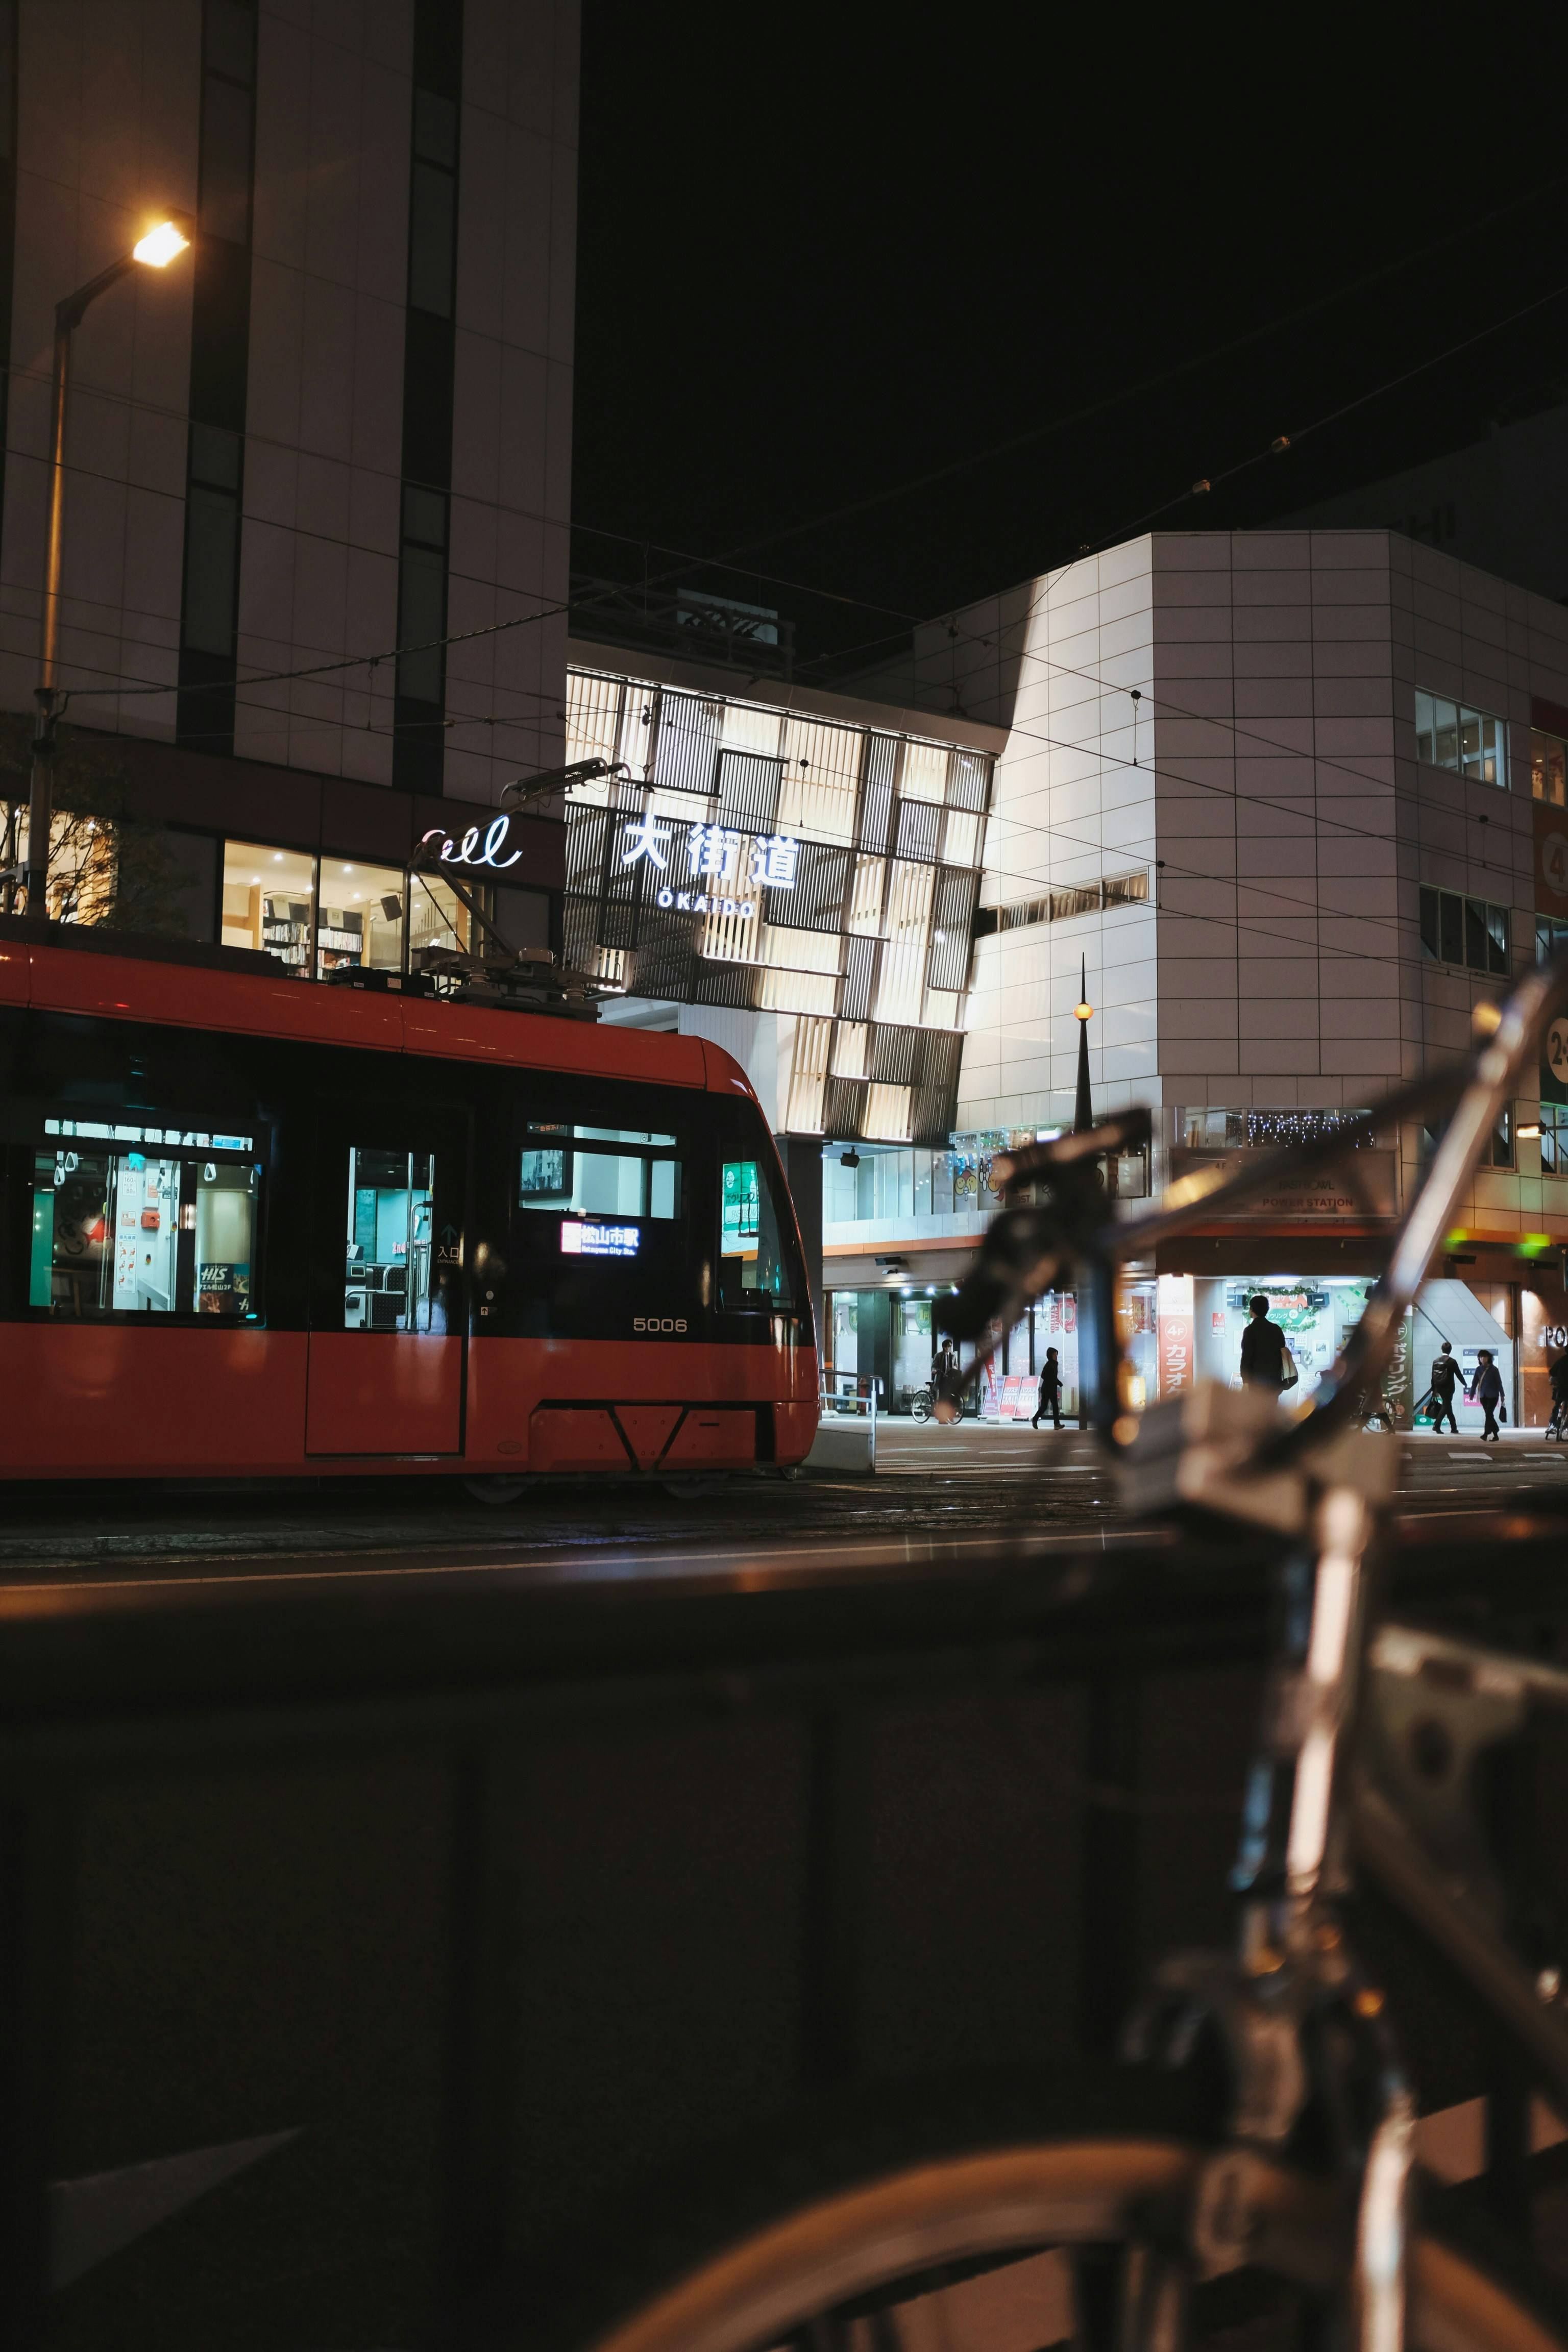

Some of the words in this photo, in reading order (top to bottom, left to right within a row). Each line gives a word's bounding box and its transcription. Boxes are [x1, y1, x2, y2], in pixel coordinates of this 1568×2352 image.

[622, 814, 799, 889] 大街道
[1263, 1198, 1303, 1207] POWER
[1306, 1198, 1353, 1207] STATION
[581, 1225, 639, 1247] 松山市駅
[438, 1246, 459, 1258] 入口
[609, 1246, 622, 1256] City
[201, 1268, 228, 1281] HIS
[633, 1318, 687, 1332] 5006
[1167, 1326, 1185, 1336] 4F
[1546, 1326, 1568, 1348] PO
[1387, 1343, 1408, 1395] ボウリング
